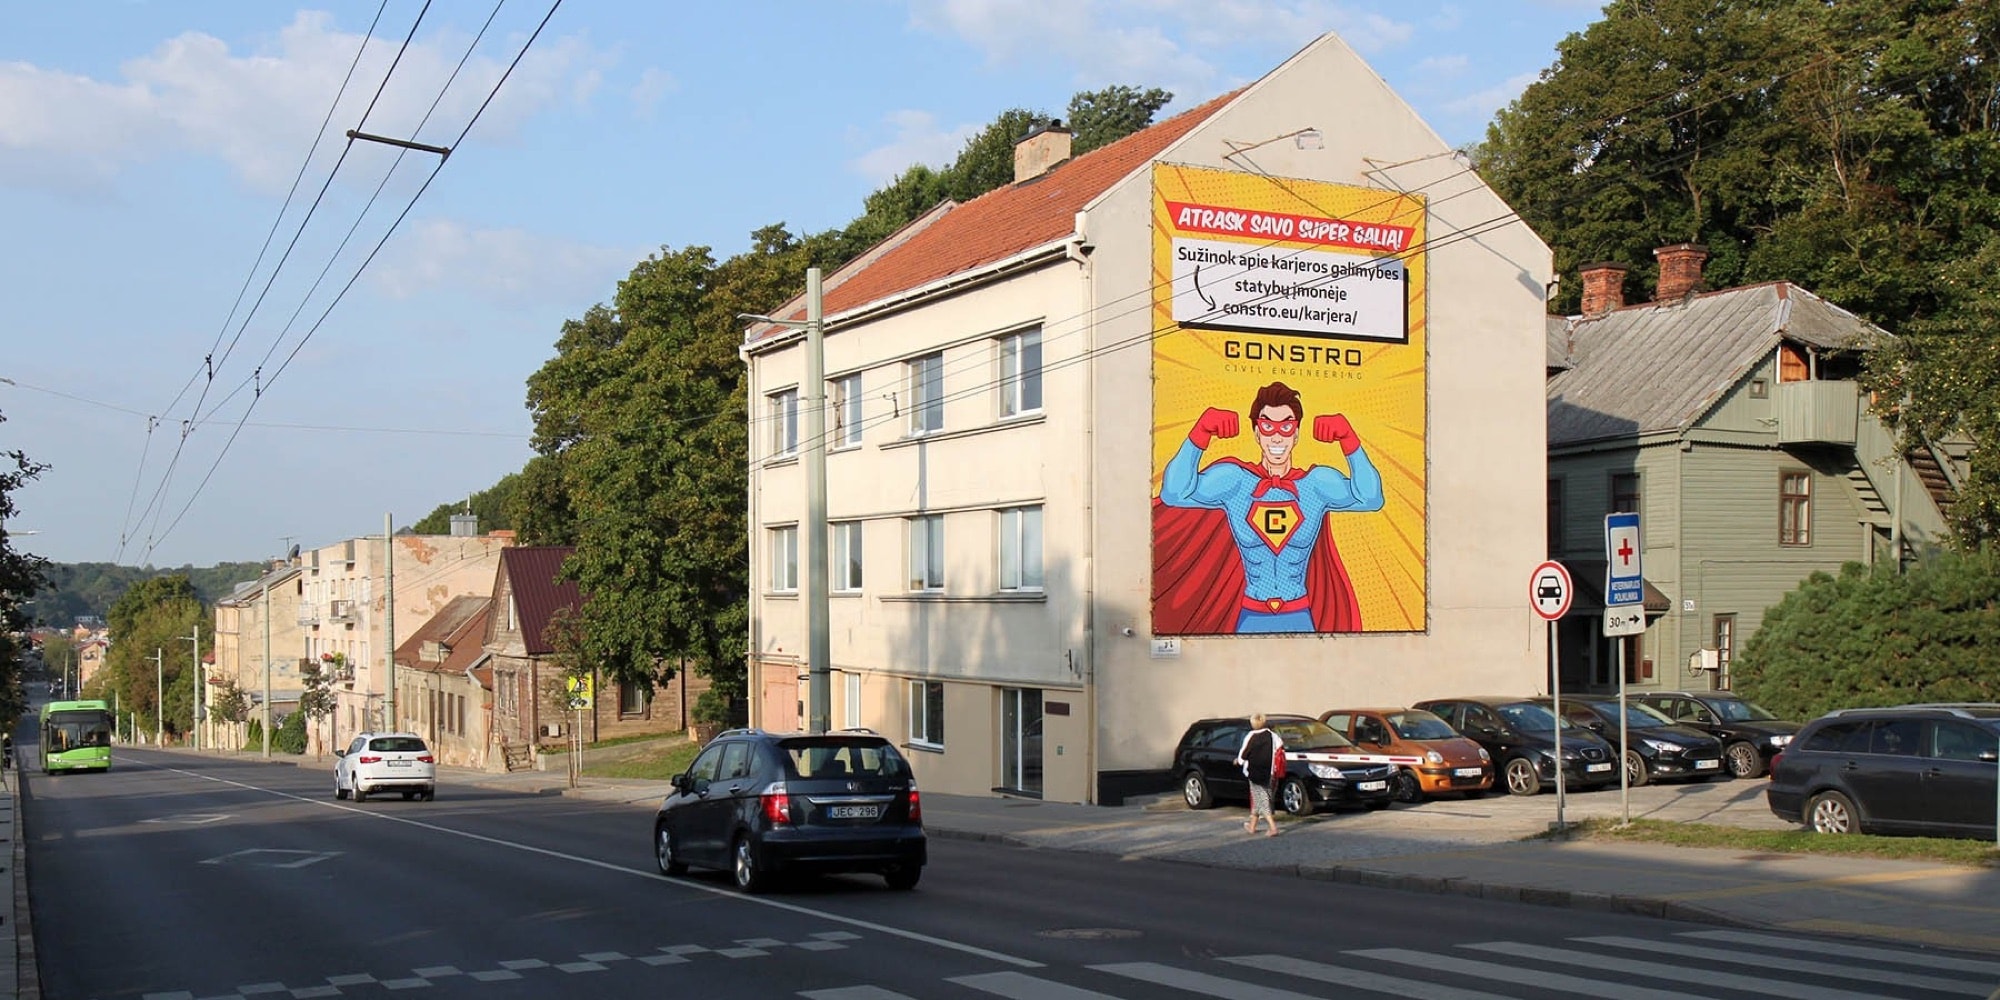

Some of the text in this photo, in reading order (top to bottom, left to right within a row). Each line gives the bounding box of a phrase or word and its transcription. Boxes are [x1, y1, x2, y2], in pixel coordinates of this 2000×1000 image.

[1178, 207, 1247, 232] ATRASK
[1250, 214, 1294, 237] SAVO
[1298, 219, 1350, 242] SUPER
[1178, 247, 1400, 281] Sužinok apie karjeros galimybes
[1235, 280, 1347, 303] statybų įmonėje
[1223, 303, 1358, 326] constro.eu/karjera/
[1225, 340, 1361, 366] CONSTRO
[1225, 364, 1362, 380] CIVIL ENGINEERING
